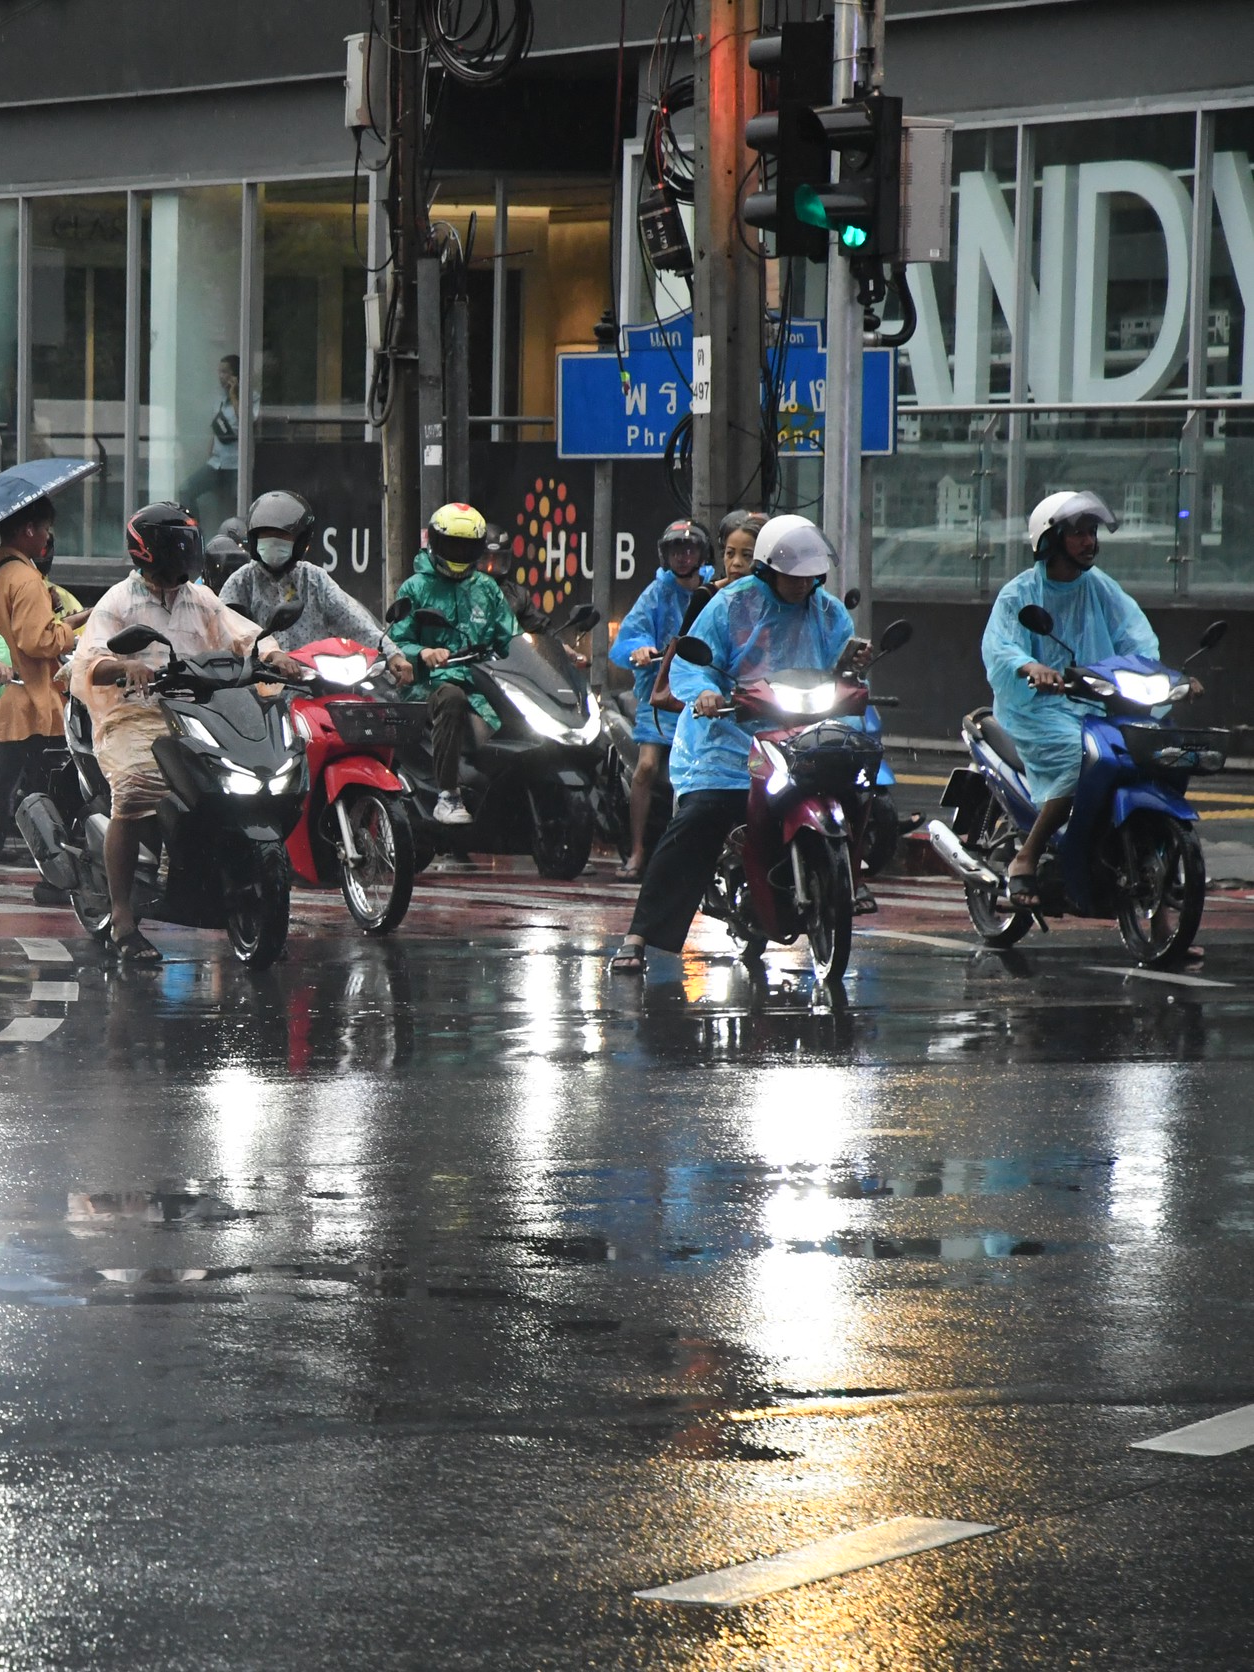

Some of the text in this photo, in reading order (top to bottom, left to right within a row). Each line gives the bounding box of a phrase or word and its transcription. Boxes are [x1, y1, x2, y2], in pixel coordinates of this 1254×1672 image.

[693, 381, 710, 400] 497
[627, 425, 680, 447] Phr
[546, 531, 636, 580] HUB
